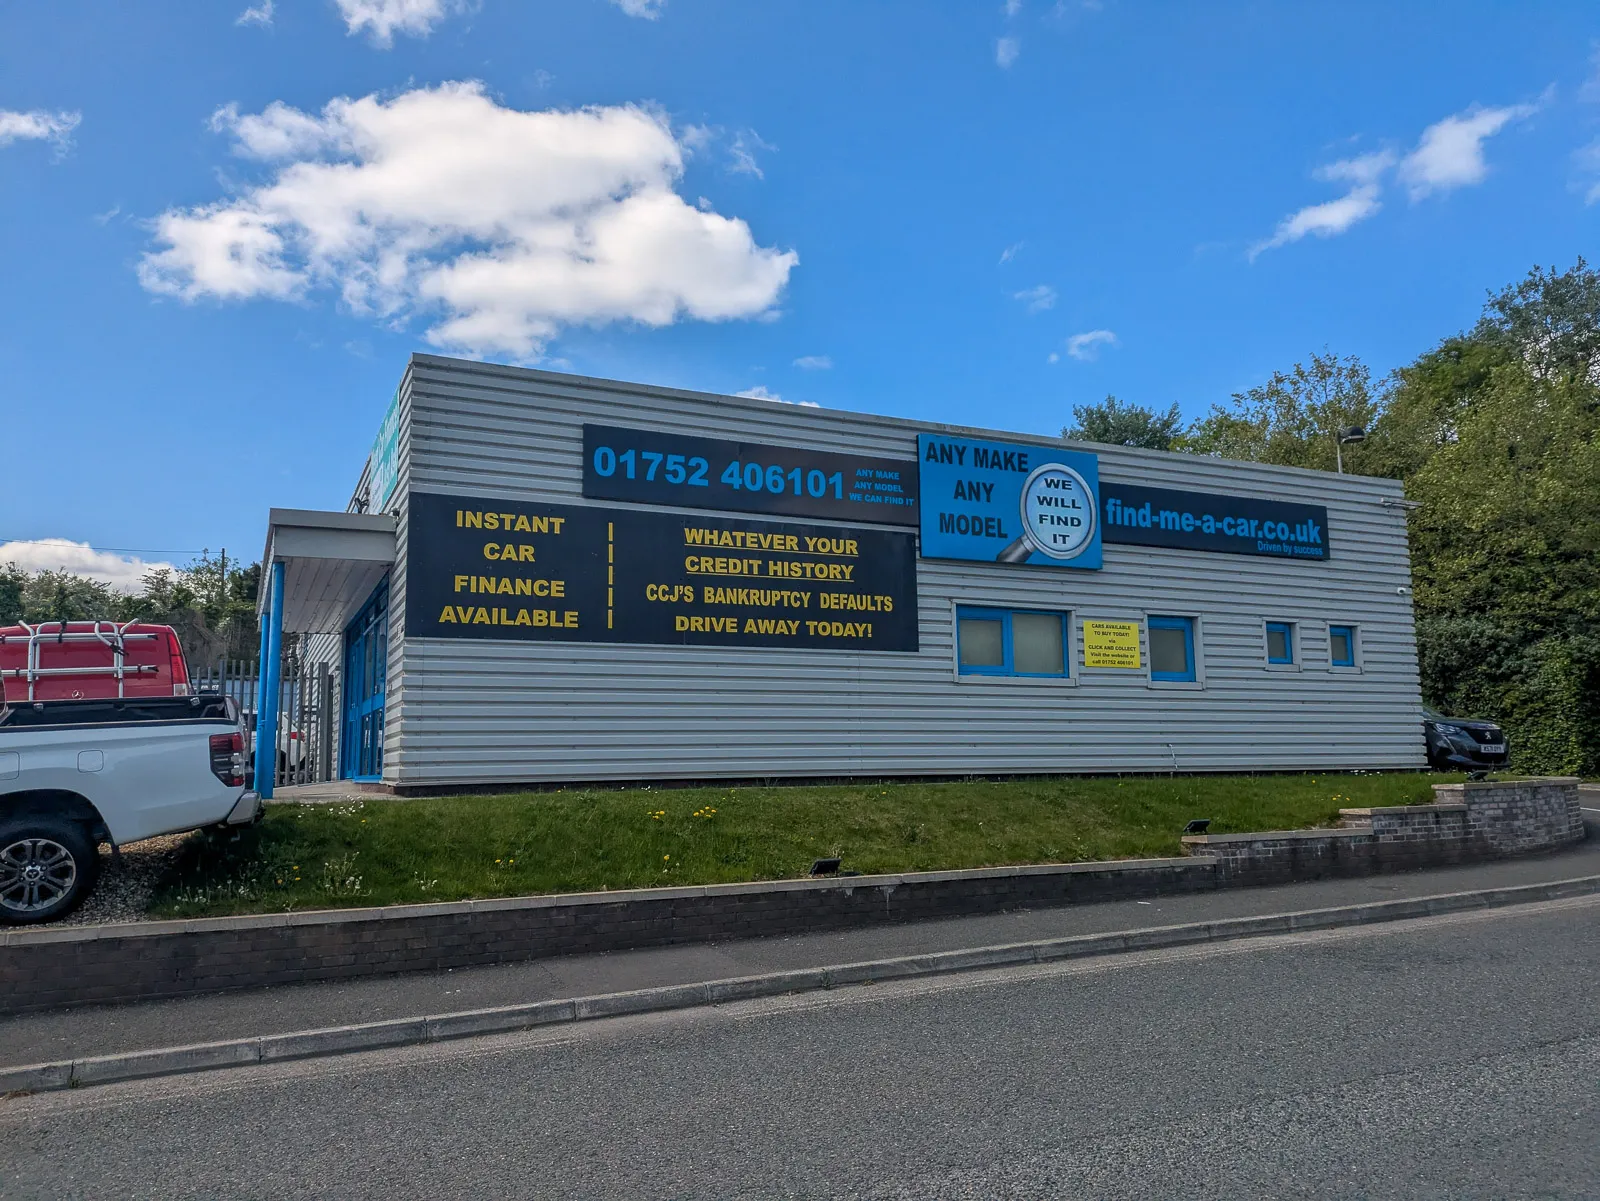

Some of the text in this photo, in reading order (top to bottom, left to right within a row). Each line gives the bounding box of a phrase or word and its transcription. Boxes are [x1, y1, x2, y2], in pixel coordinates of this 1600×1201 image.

[926, 442, 1029, 473] ANY MAKE
[593, 446, 843, 500] 01752 406101
[856, 468, 900, 480] ANY MAKE
[1044, 478, 1072, 490] WE
[854, 481, 904, 493] ANY MODEL
[954, 480, 995, 503] ANY
[849, 492, 914, 506] WE CAN FIND IT
[1036, 496, 1082, 510] WILL
[456, 510, 565, 534] INSTANT
[939, 512, 1008, 538] MODEL
[1038, 514, 1082, 528] FIND
[1106, 498, 1322, 544] find-me-a-car.co.uk
[685, 528, 858, 555] WHATEVER YOUR
[1052, 534, 1070, 545] IT
[1258, 541, 1324, 556] Driven by success
[484, 543, 535, 562] CAR
[685, 556, 854, 580] CREDIT HISTORY
[455, 575, 565, 598] FINANCE
[704, 584, 811, 608] BANKRUPTCY
[820, 593, 893, 612] DEFAULTS
[440, 605, 578, 628] AVAILABLE
[676, 616, 872, 638] DRIVE AWAY TODAY!
